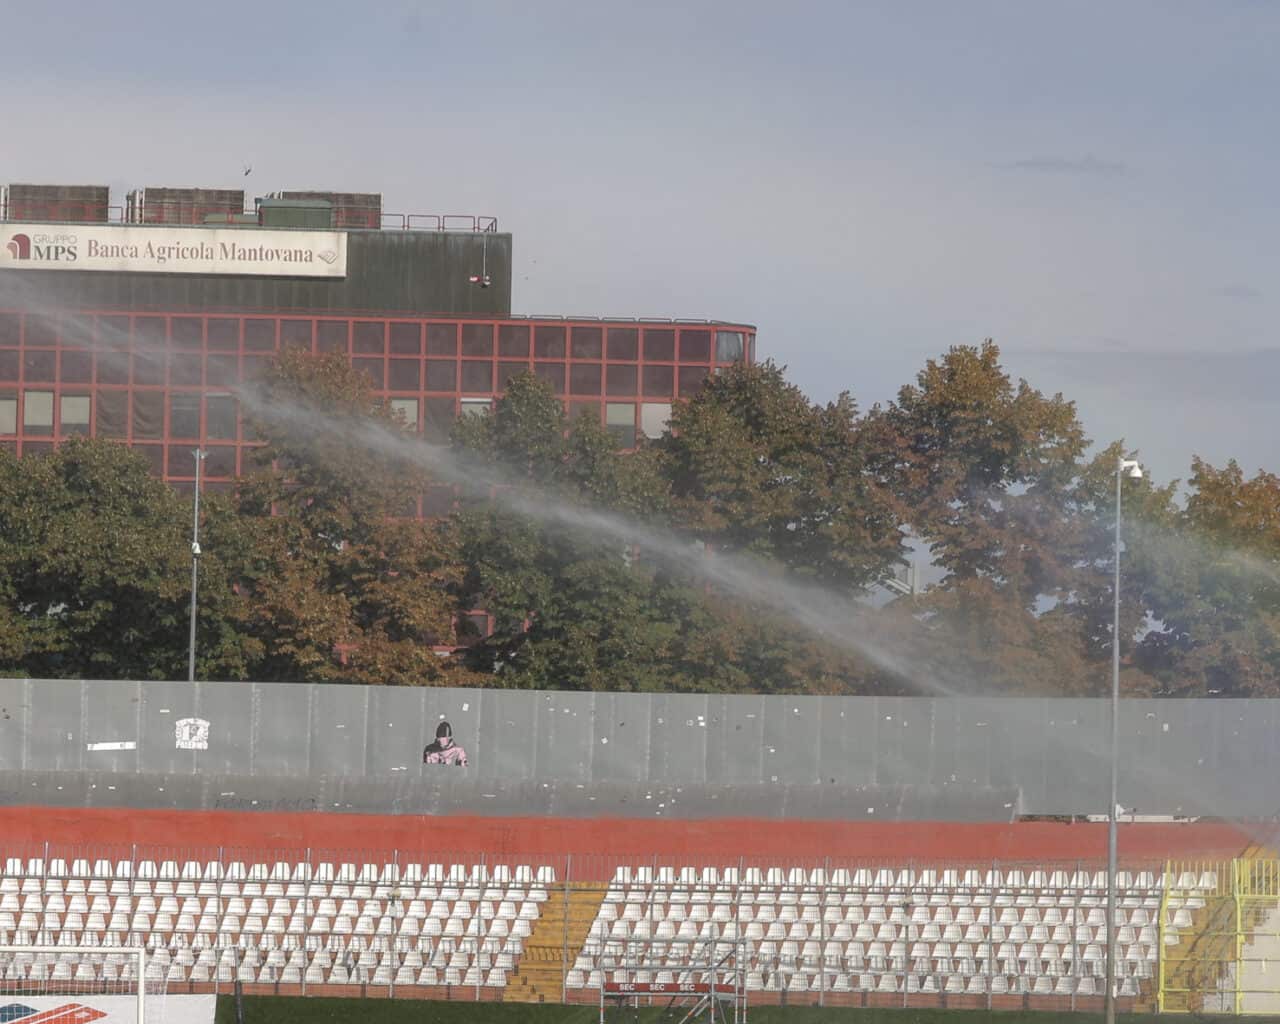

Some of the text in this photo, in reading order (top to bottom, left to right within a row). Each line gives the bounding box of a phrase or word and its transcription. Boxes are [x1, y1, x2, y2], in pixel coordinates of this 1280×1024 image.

[33, 234, 77, 244] GRUPPO
[34, 245, 77, 261] MPS
[87, 240, 313, 263] Banca Agricola Mantovana
